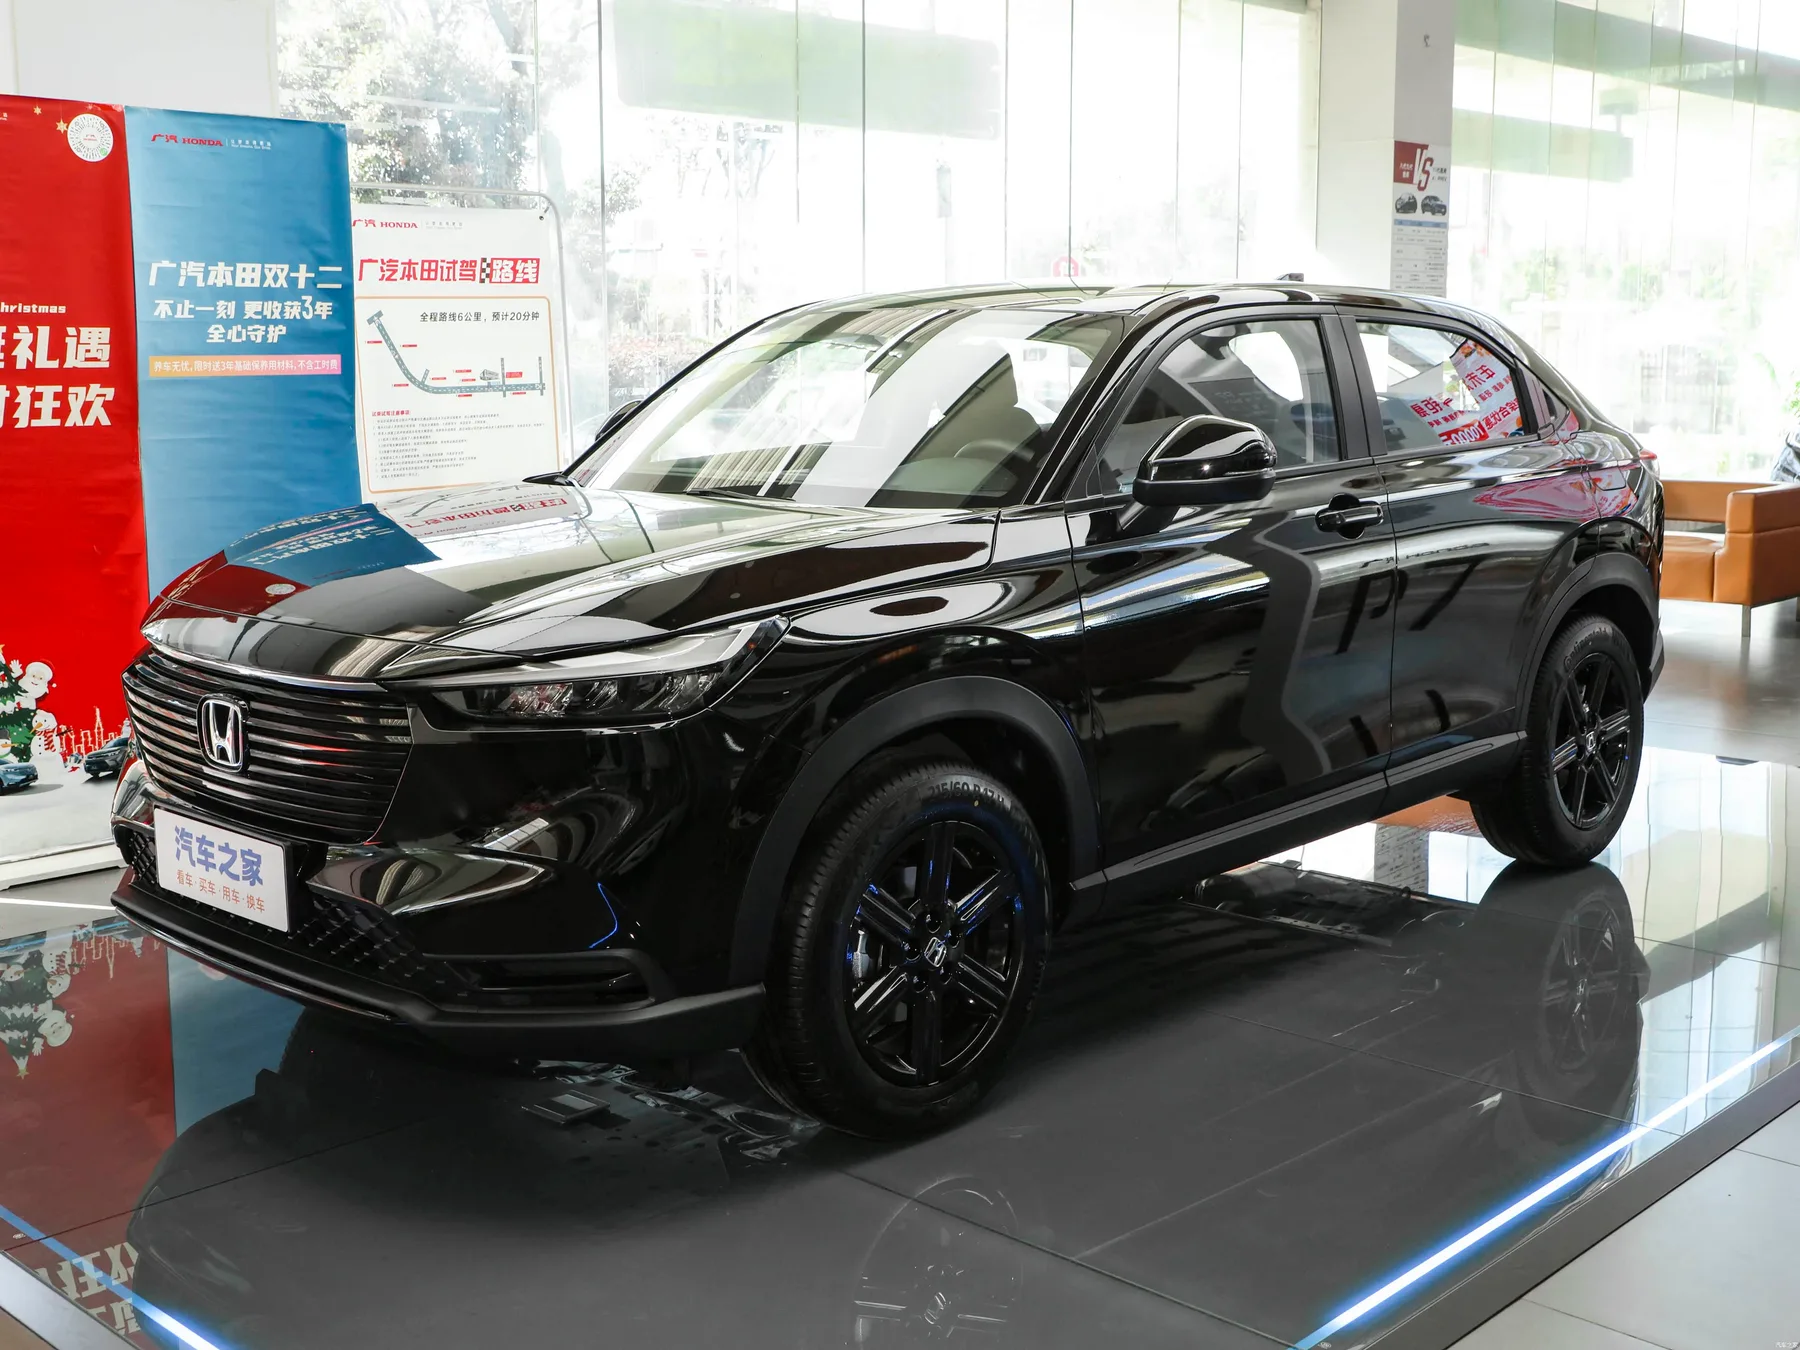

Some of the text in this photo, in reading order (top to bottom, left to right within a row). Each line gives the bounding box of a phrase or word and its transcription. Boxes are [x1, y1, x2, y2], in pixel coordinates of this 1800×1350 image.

[182, 137, 223, 147] HONDA
[380, 221, 418, 229] HONDA
[149, 261, 342, 289] 广汽本田双十二
[154, 295, 333, 320] 不止一刻 更收获3年
[206, 324, 286, 344] 全心守护
[174, 825, 263, 887] 汽车之家
